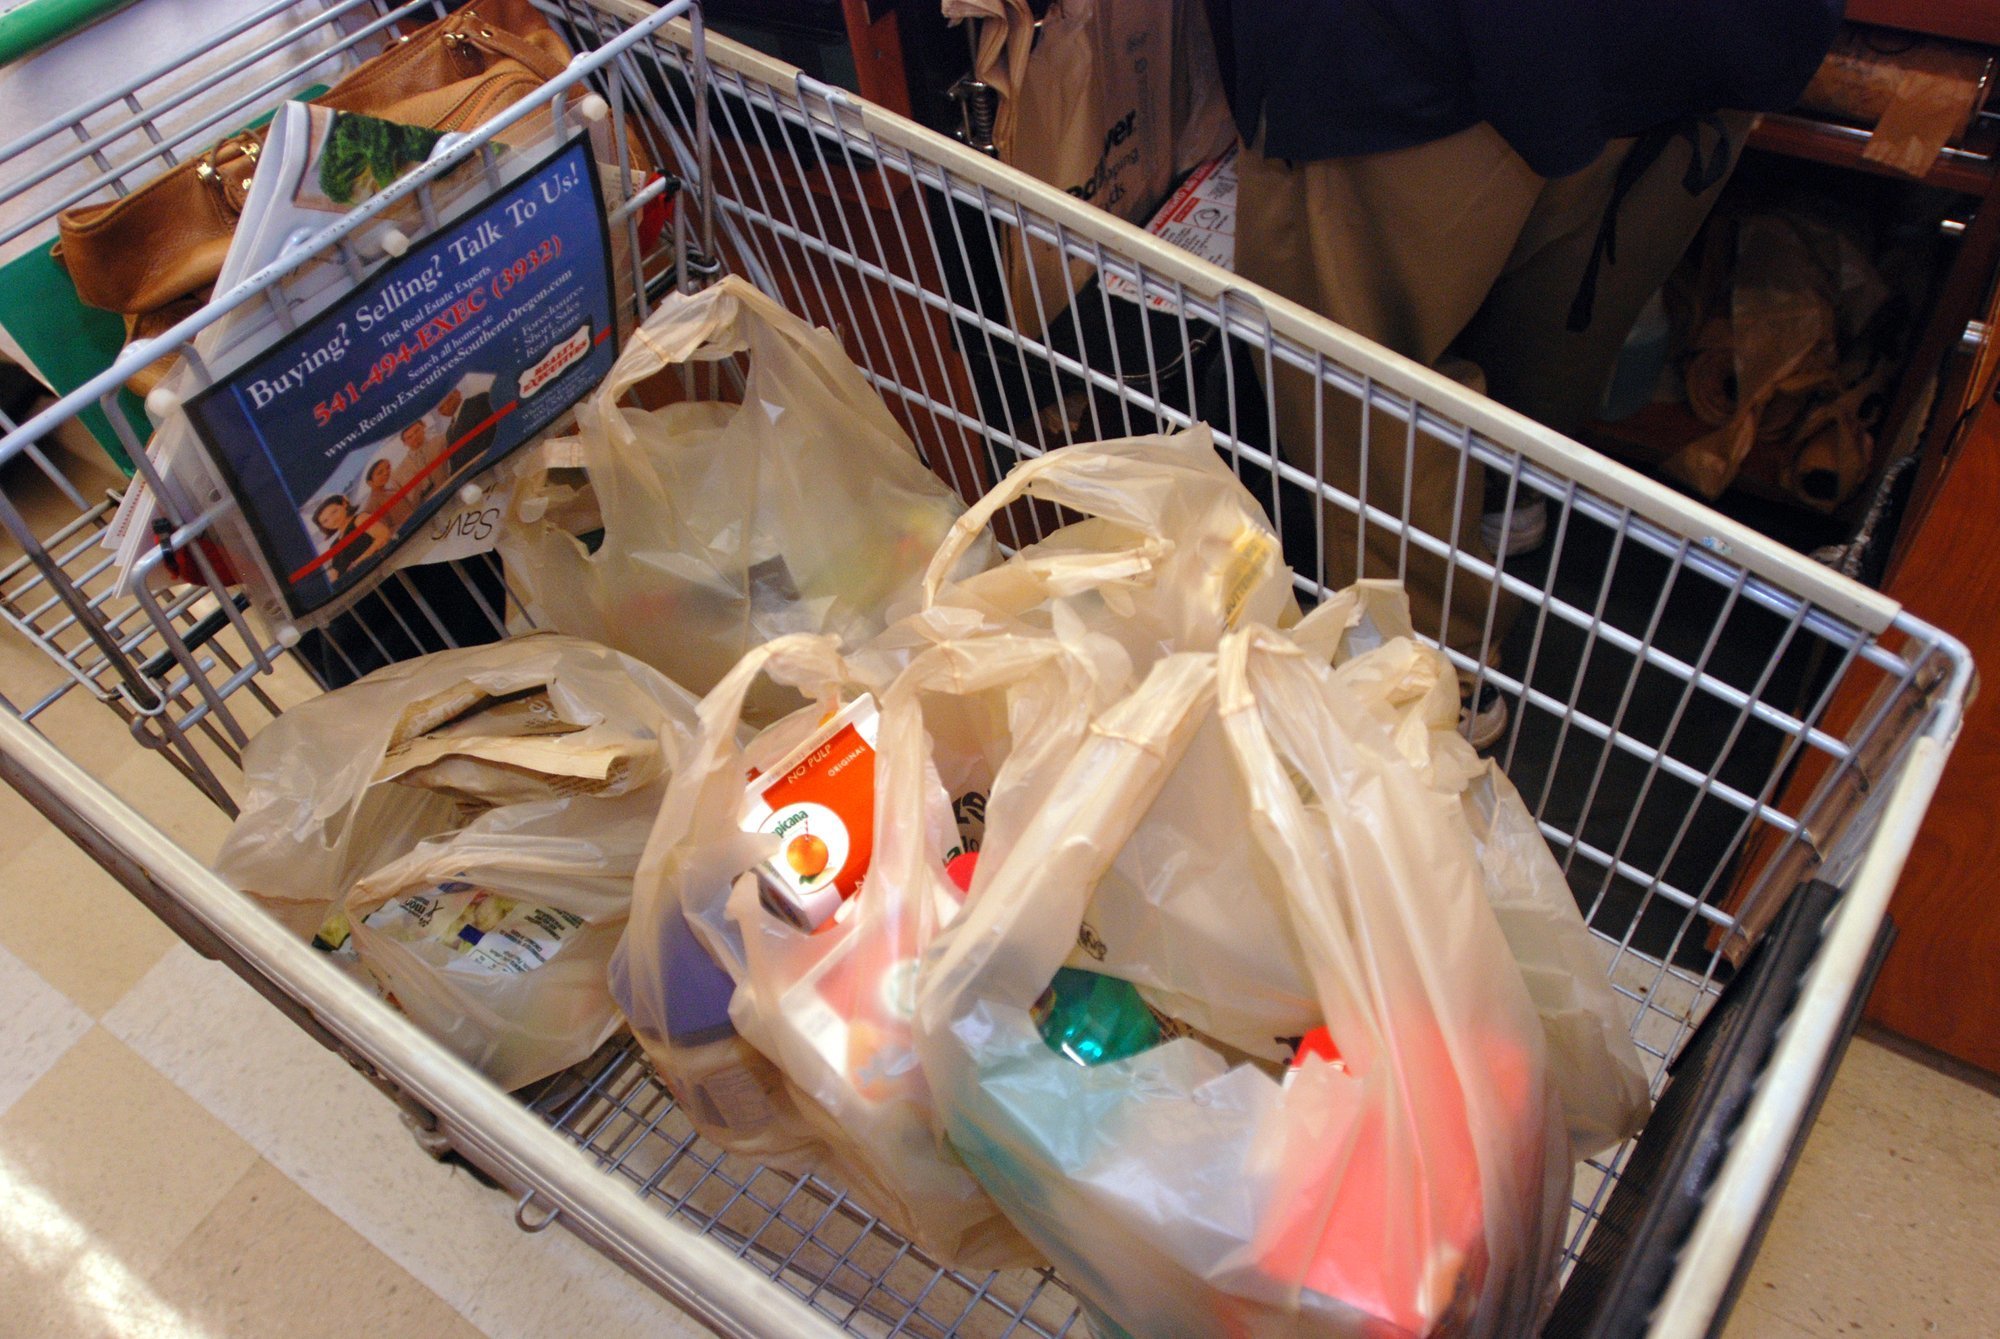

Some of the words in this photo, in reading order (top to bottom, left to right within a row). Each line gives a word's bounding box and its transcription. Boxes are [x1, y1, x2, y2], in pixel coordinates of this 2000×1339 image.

[246, 322, 350, 410] Buying?
[355, 254, 443, 332] Selling?
[447, 220, 503, 265] Talk
[505, 198, 537, 228] To
[539, 162, 579, 204] Us!
[491, 234, 562, 299] (3932)
[379, 329, 401, 347] The
[400, 309, 425, 333] Real
[424, 291, 454, 316] Estate
[454, 266, 491, 294] Experts
[521, 285, 585, 337] Foreclosures
[523, 321, 552, 346] Short
[555, 301, 581, 321] Sales
[408, 354, 439, 380] Search
[440, 342, 453, 358] all
[451, 325, 481, 348] homes
[526, 337, 549, 359] Real
[550, 312, 581, 339] Estate
[323, 269, 573, 458] www.RealtyExecutivesSouthernOregon.com
[787, 765, 806, 785] NO
[807, 743, 832, 768] PULP
[827, 745, 866, 777] ORIGINAL
[771, 810, 809, 839] picana
